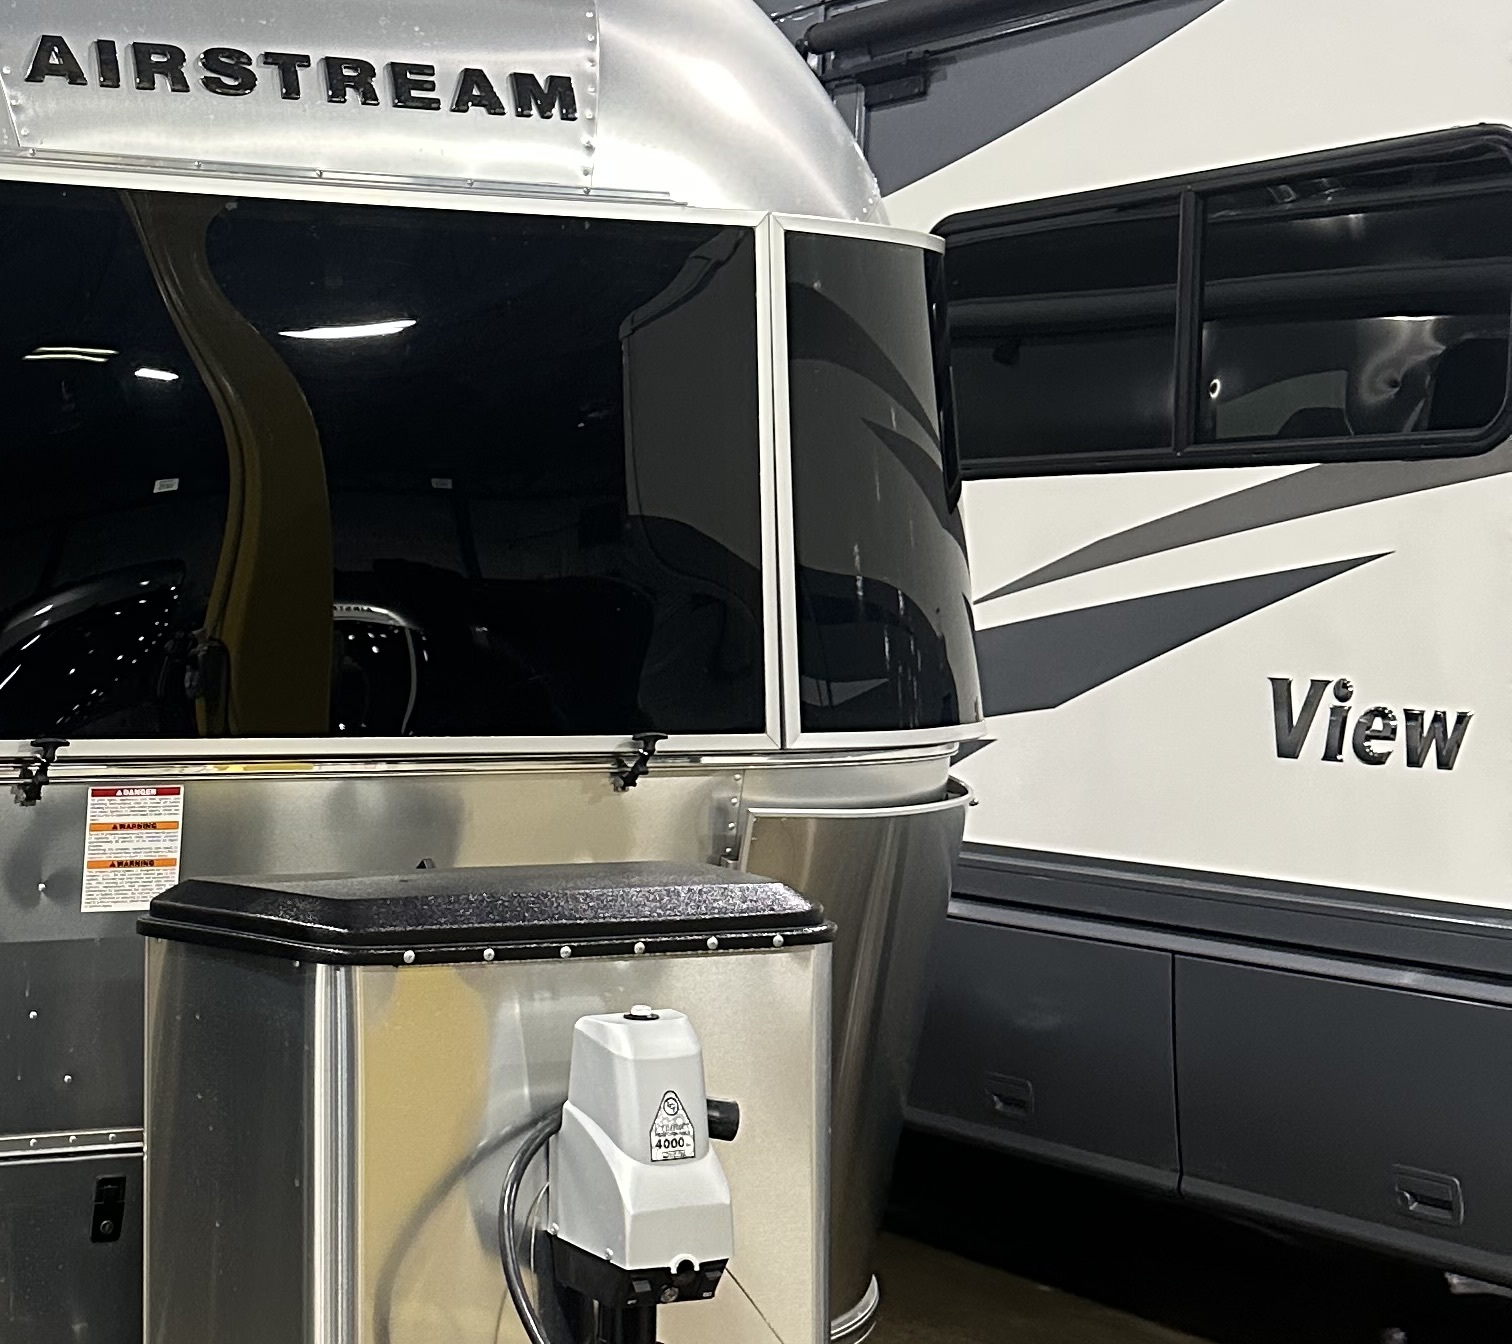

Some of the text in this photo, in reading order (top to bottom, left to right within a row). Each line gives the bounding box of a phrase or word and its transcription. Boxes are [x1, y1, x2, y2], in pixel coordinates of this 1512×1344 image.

[25, 34, 578, 121] AIRSTREAM
[1267, 676, 1475, 771] View
[123, 788, 157, 796] DANGER
[119, 822, 157, 830] WARNING
[117, 860, 155, 868] WARNING
[655, 1136, 685, 1149] 4000
